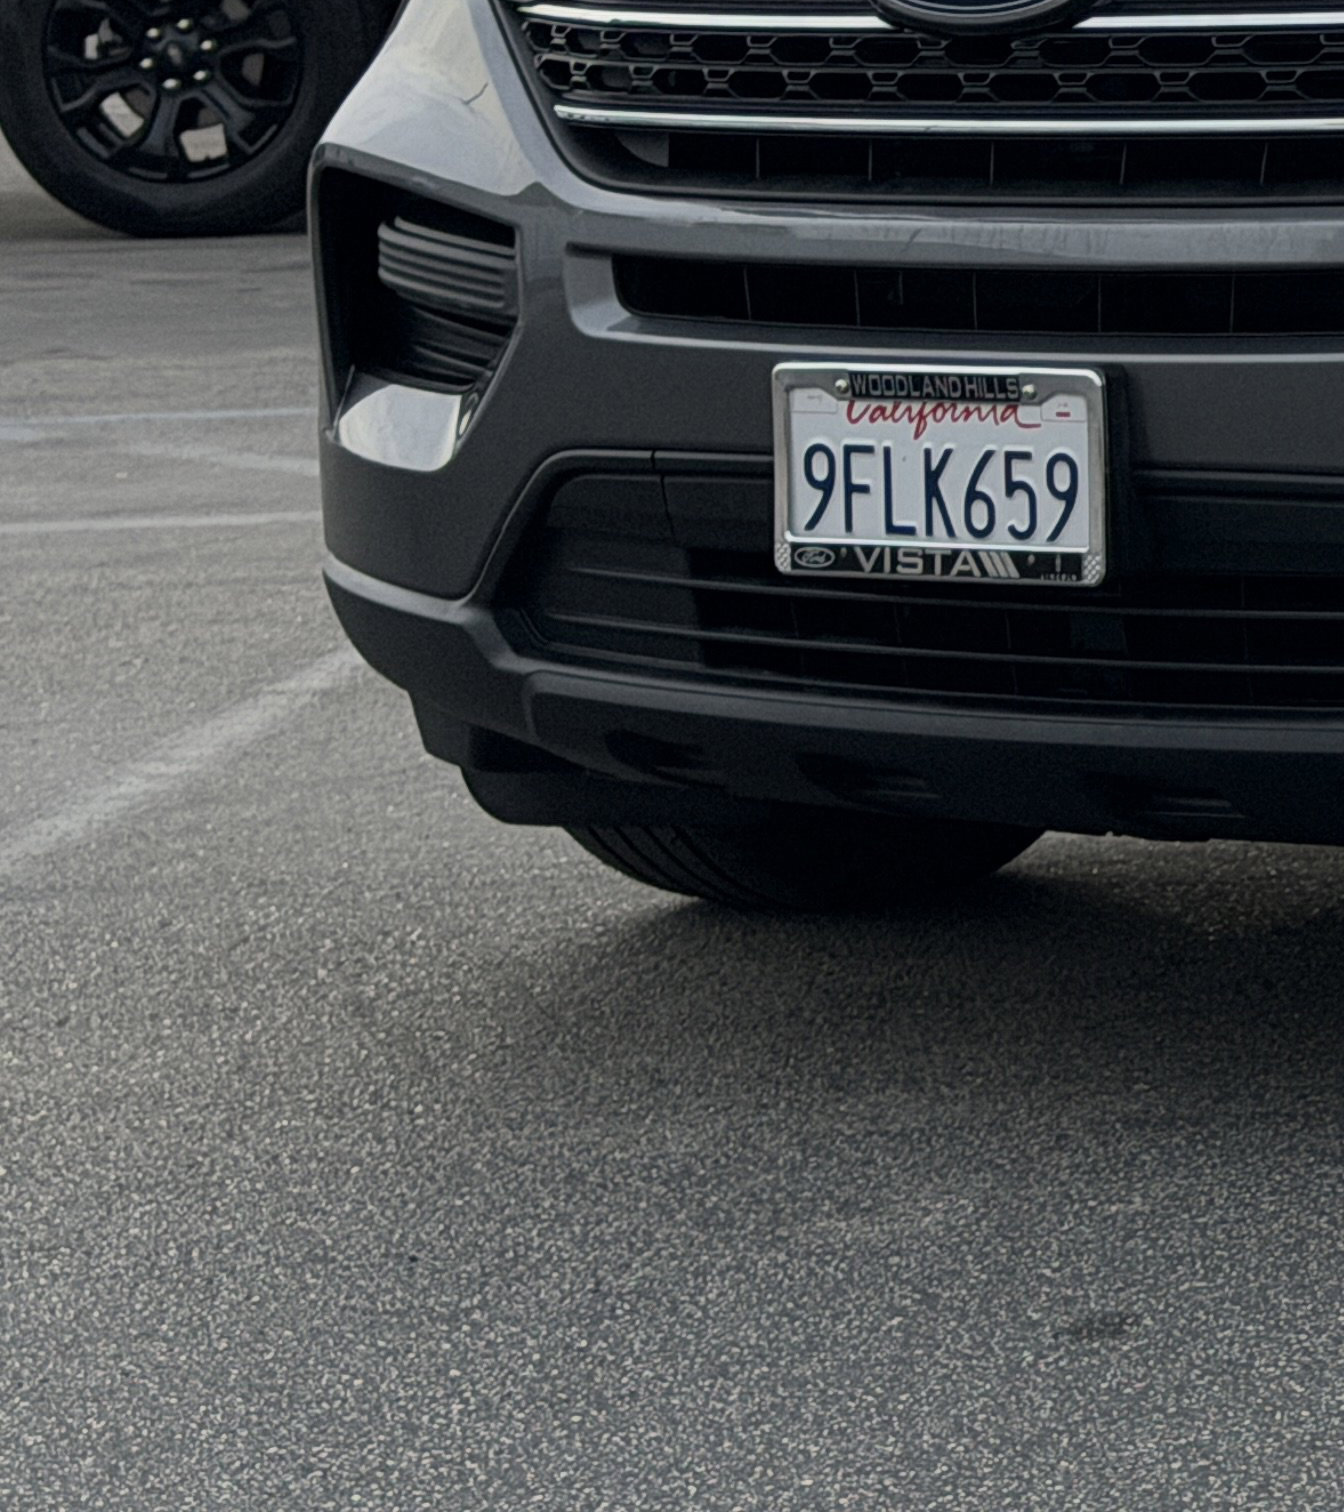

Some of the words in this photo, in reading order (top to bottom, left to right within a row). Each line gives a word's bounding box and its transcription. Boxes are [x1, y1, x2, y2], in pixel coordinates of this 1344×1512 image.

[849, 374, 961, 398] WOODLAND
[965, 376, 1019, 399] HILLS
[846, 399, 1041, 440] California
[803, 443, 1079, 543] 9FLK659
[854, 546, 982, 576] VISTA
